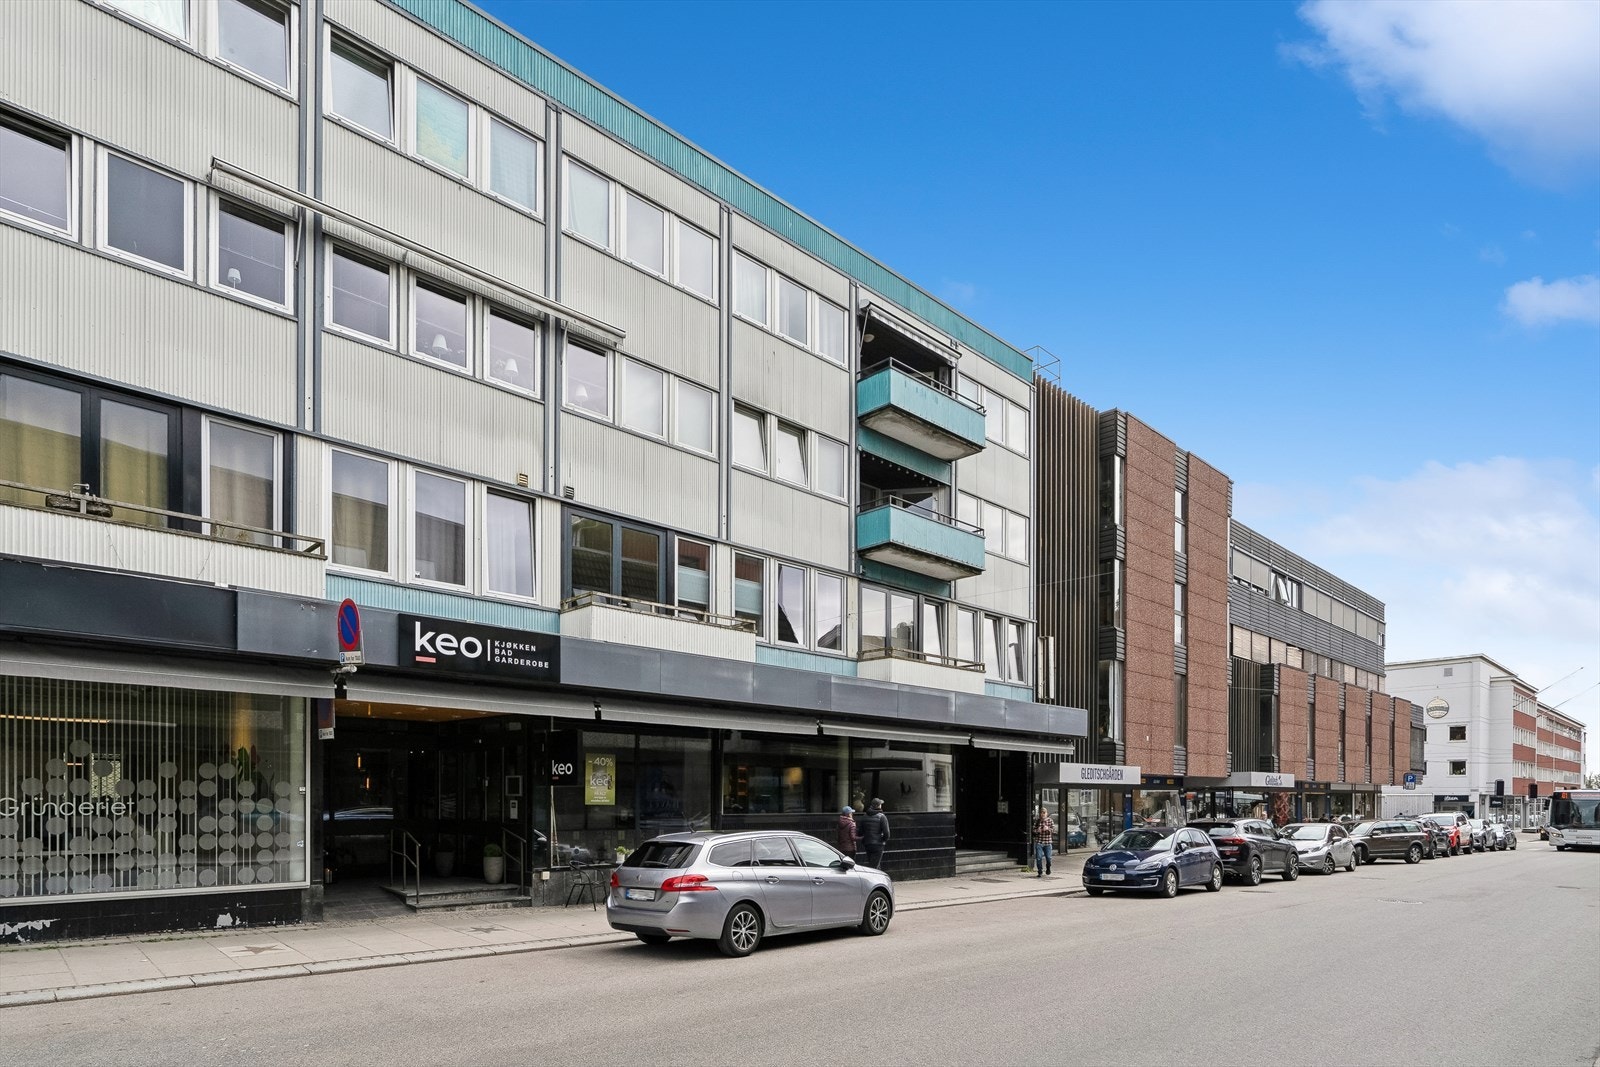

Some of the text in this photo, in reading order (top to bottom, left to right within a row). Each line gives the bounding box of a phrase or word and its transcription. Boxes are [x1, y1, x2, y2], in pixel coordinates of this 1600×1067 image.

[415, 621, 482, 658] keo
[494, 640, 536, 652] KJØKKEN
[494, 648, 513, 656] BAD
[494, 656, 549, 669] GARDEROBE
[552, 760, 573, 775] keo
[1080, 766, 1124, 781] GLEDITSCHGÅRDEN
[0, 797, 135, 816] Gründeriet
